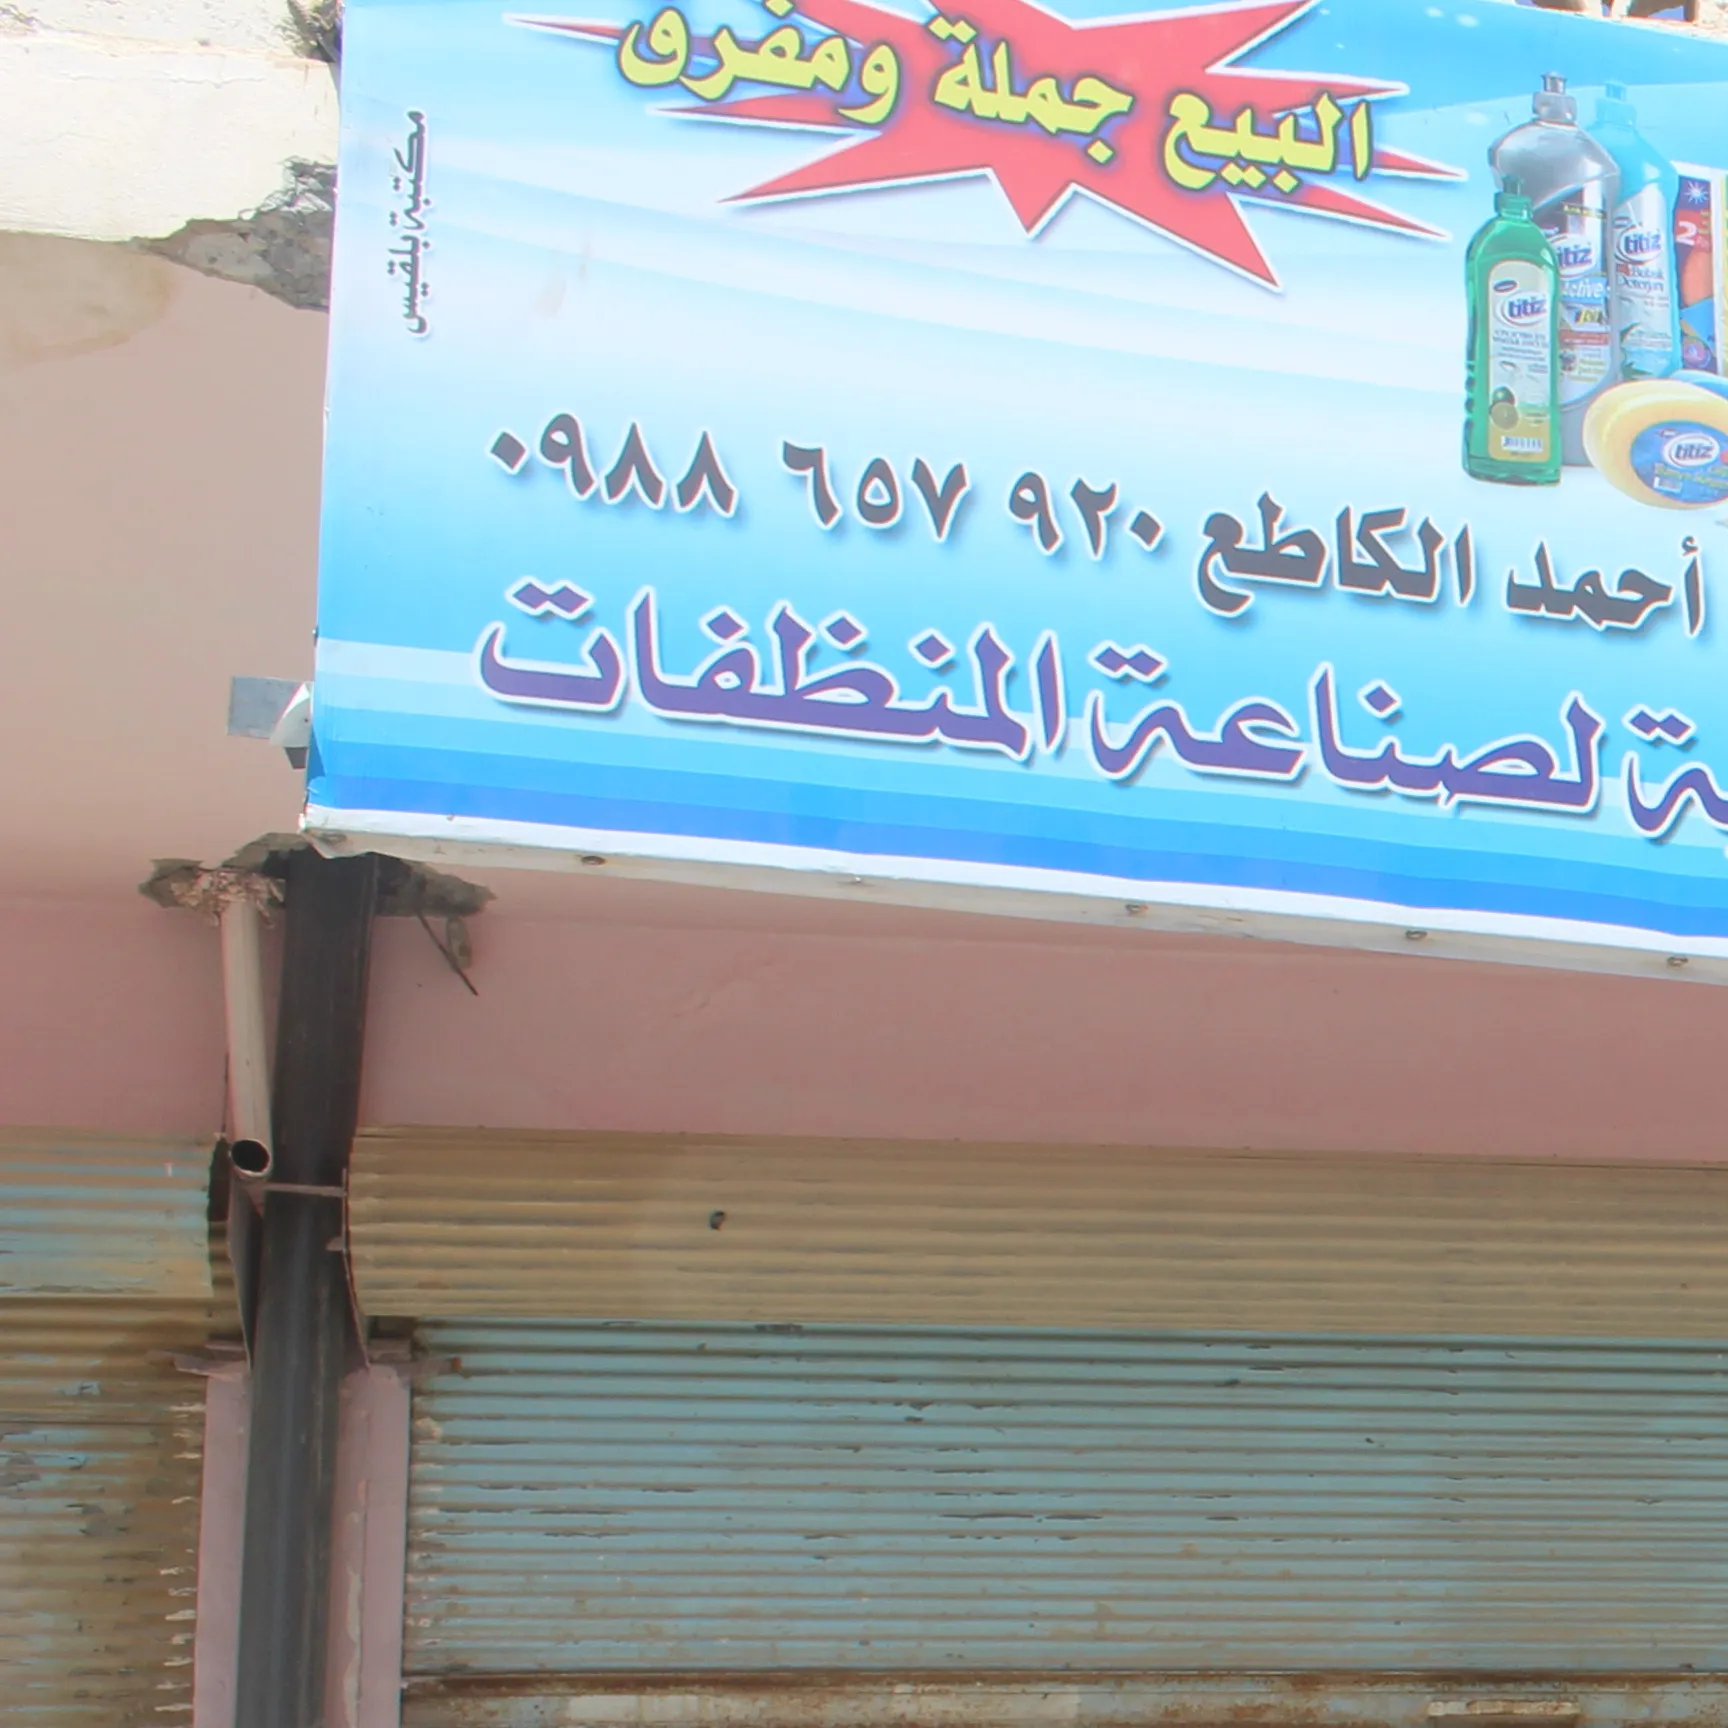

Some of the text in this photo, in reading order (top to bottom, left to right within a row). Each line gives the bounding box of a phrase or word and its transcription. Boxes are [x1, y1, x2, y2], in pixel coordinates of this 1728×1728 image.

[617, 0, 1375, 194] البيع جملة ومفرق
[387, 110, 431, 335] مكتبة بلقيس
[1556, 242, 1593, 268] itiz
[487, 410, 1706, 638] أحمد الكاطع ٠٩٨٨ ٦٥٧ ٩٢٠
[473, 578, 1063, 764] المنظفات
[1087, 640, 1604, 812] لصناعة
